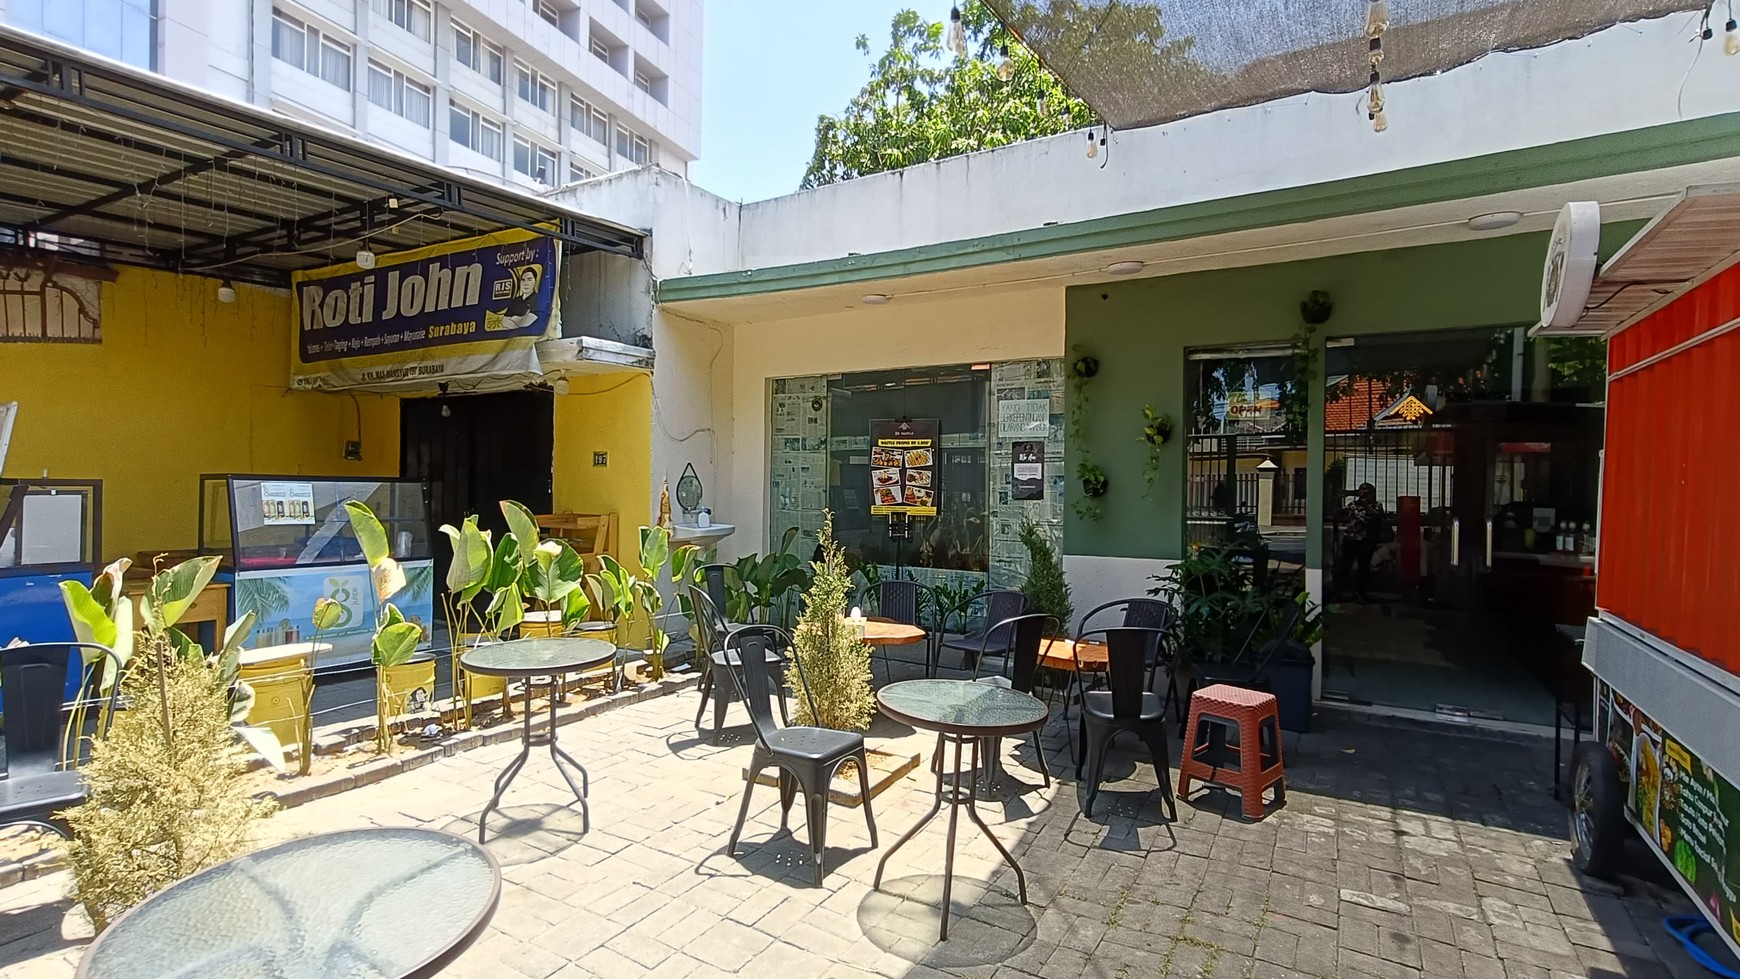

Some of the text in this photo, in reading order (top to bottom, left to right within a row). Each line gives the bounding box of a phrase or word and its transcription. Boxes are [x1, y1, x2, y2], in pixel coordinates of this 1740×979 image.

[496, 251, 526, 267] Support
[495, 282, 511, 291] RJS
[303, 262, 484, 331] Roti John
[428, 321, 476, 339] Surabaya
[418, 364, 444, 375] SURABAYA
[1001, 402, 1048, 412] YANG TIDAK
[1230, 406, 1262, 415] OPEN
[595, 455, 606, 464] 197
